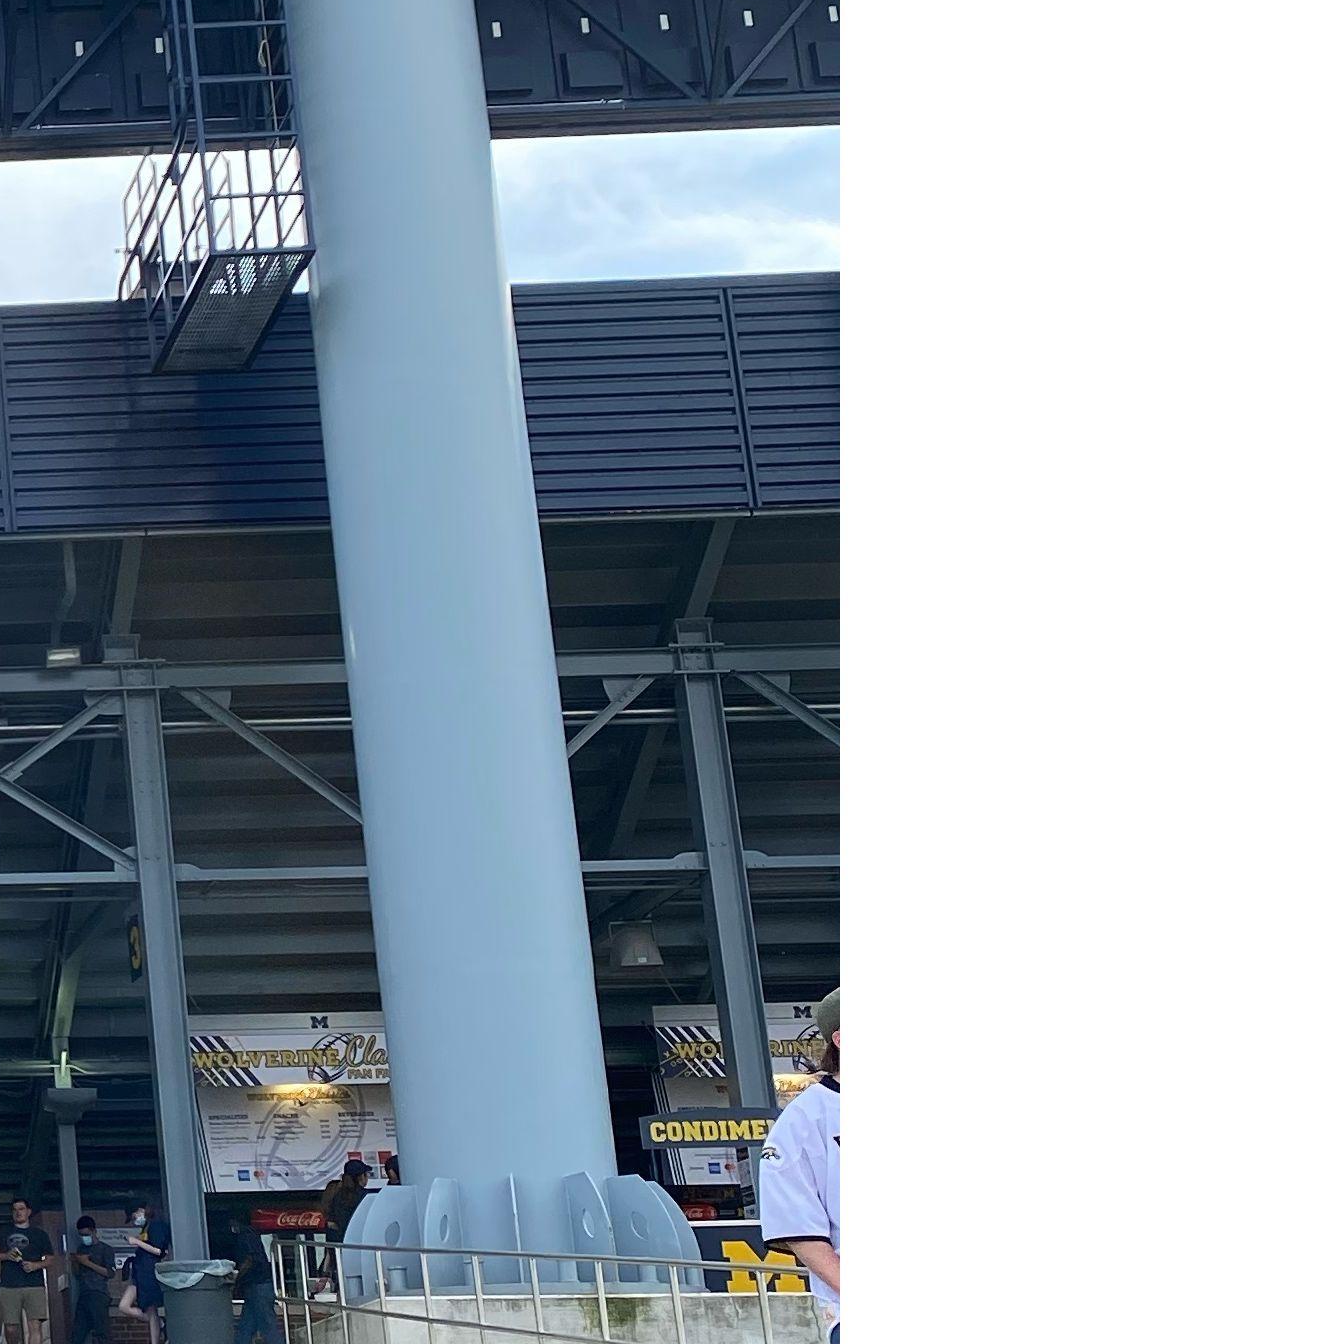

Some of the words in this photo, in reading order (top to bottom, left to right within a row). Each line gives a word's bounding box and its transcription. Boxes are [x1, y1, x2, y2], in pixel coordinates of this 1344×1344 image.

[130, 926, 142, 970] 3
[310, 1015, 329, 1029] M
[792, 1005, 813, 1019] M
[193, 1048, 340, 1069] WOLVERINE
[344, 1033, 389, 1068] Cla
[347, 1068, 373, 1080] FAN
[721, 1240, 807, 1293] M
